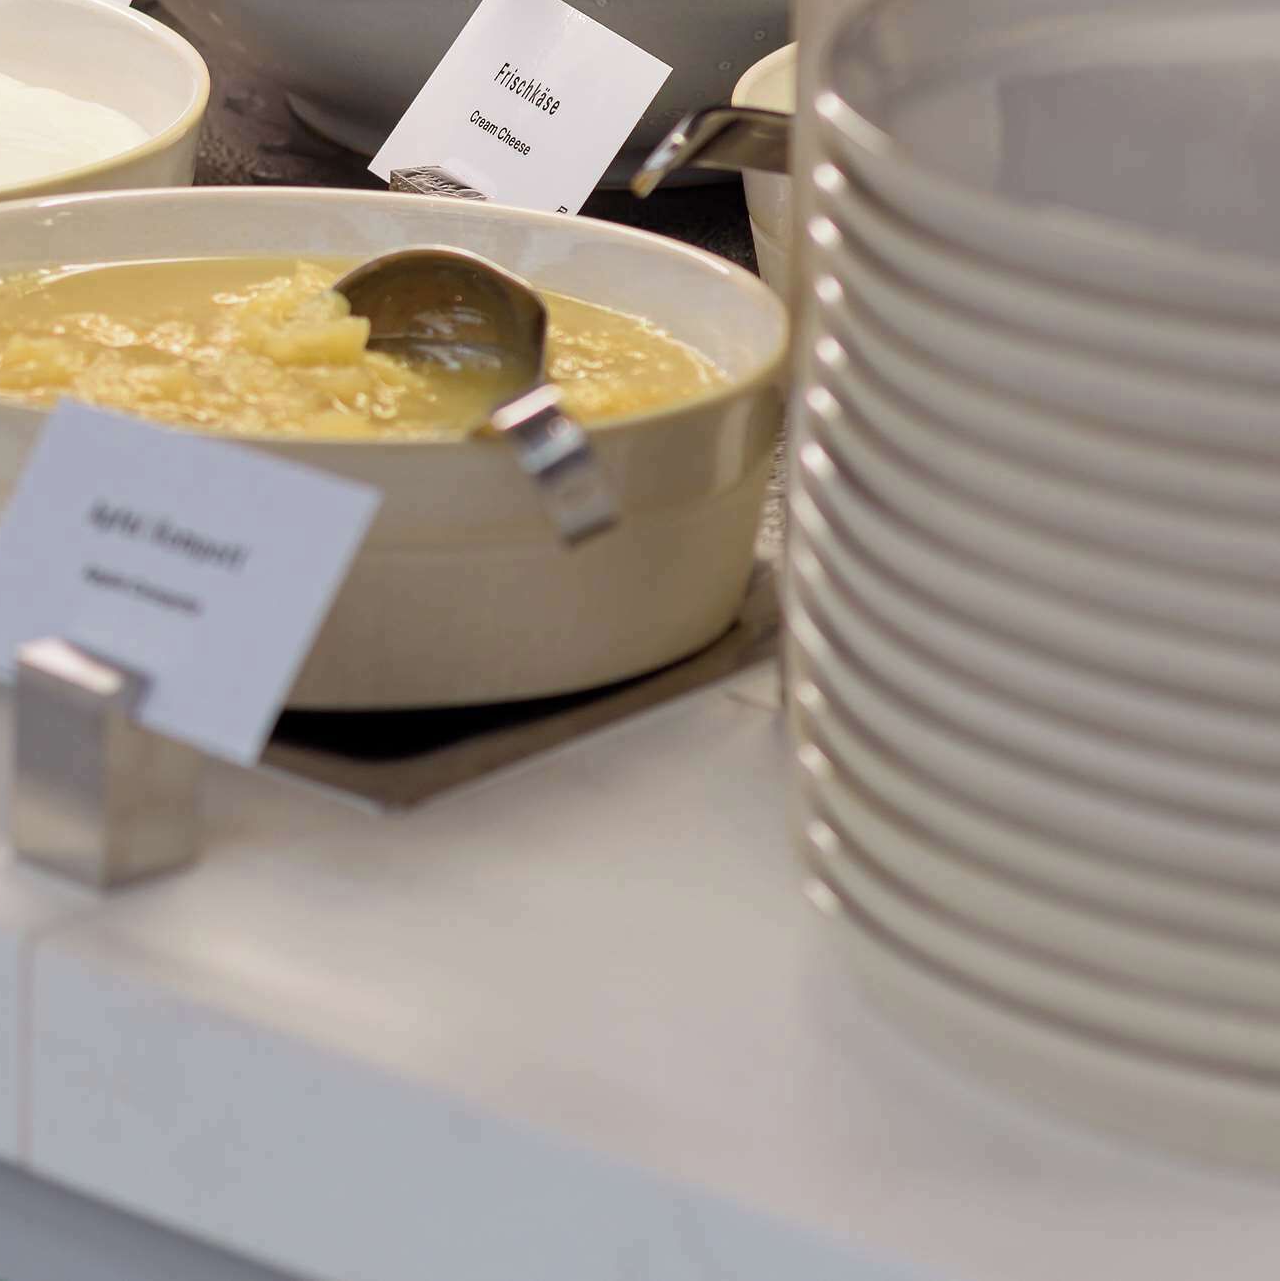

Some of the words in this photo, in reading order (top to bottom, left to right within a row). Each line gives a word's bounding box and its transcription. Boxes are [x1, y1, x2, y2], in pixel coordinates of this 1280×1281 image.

[493, 62, 561, 116] Frischkäse
[469, 110, 499, 136] Cream
[497, 127, 532, 156] Cheese
